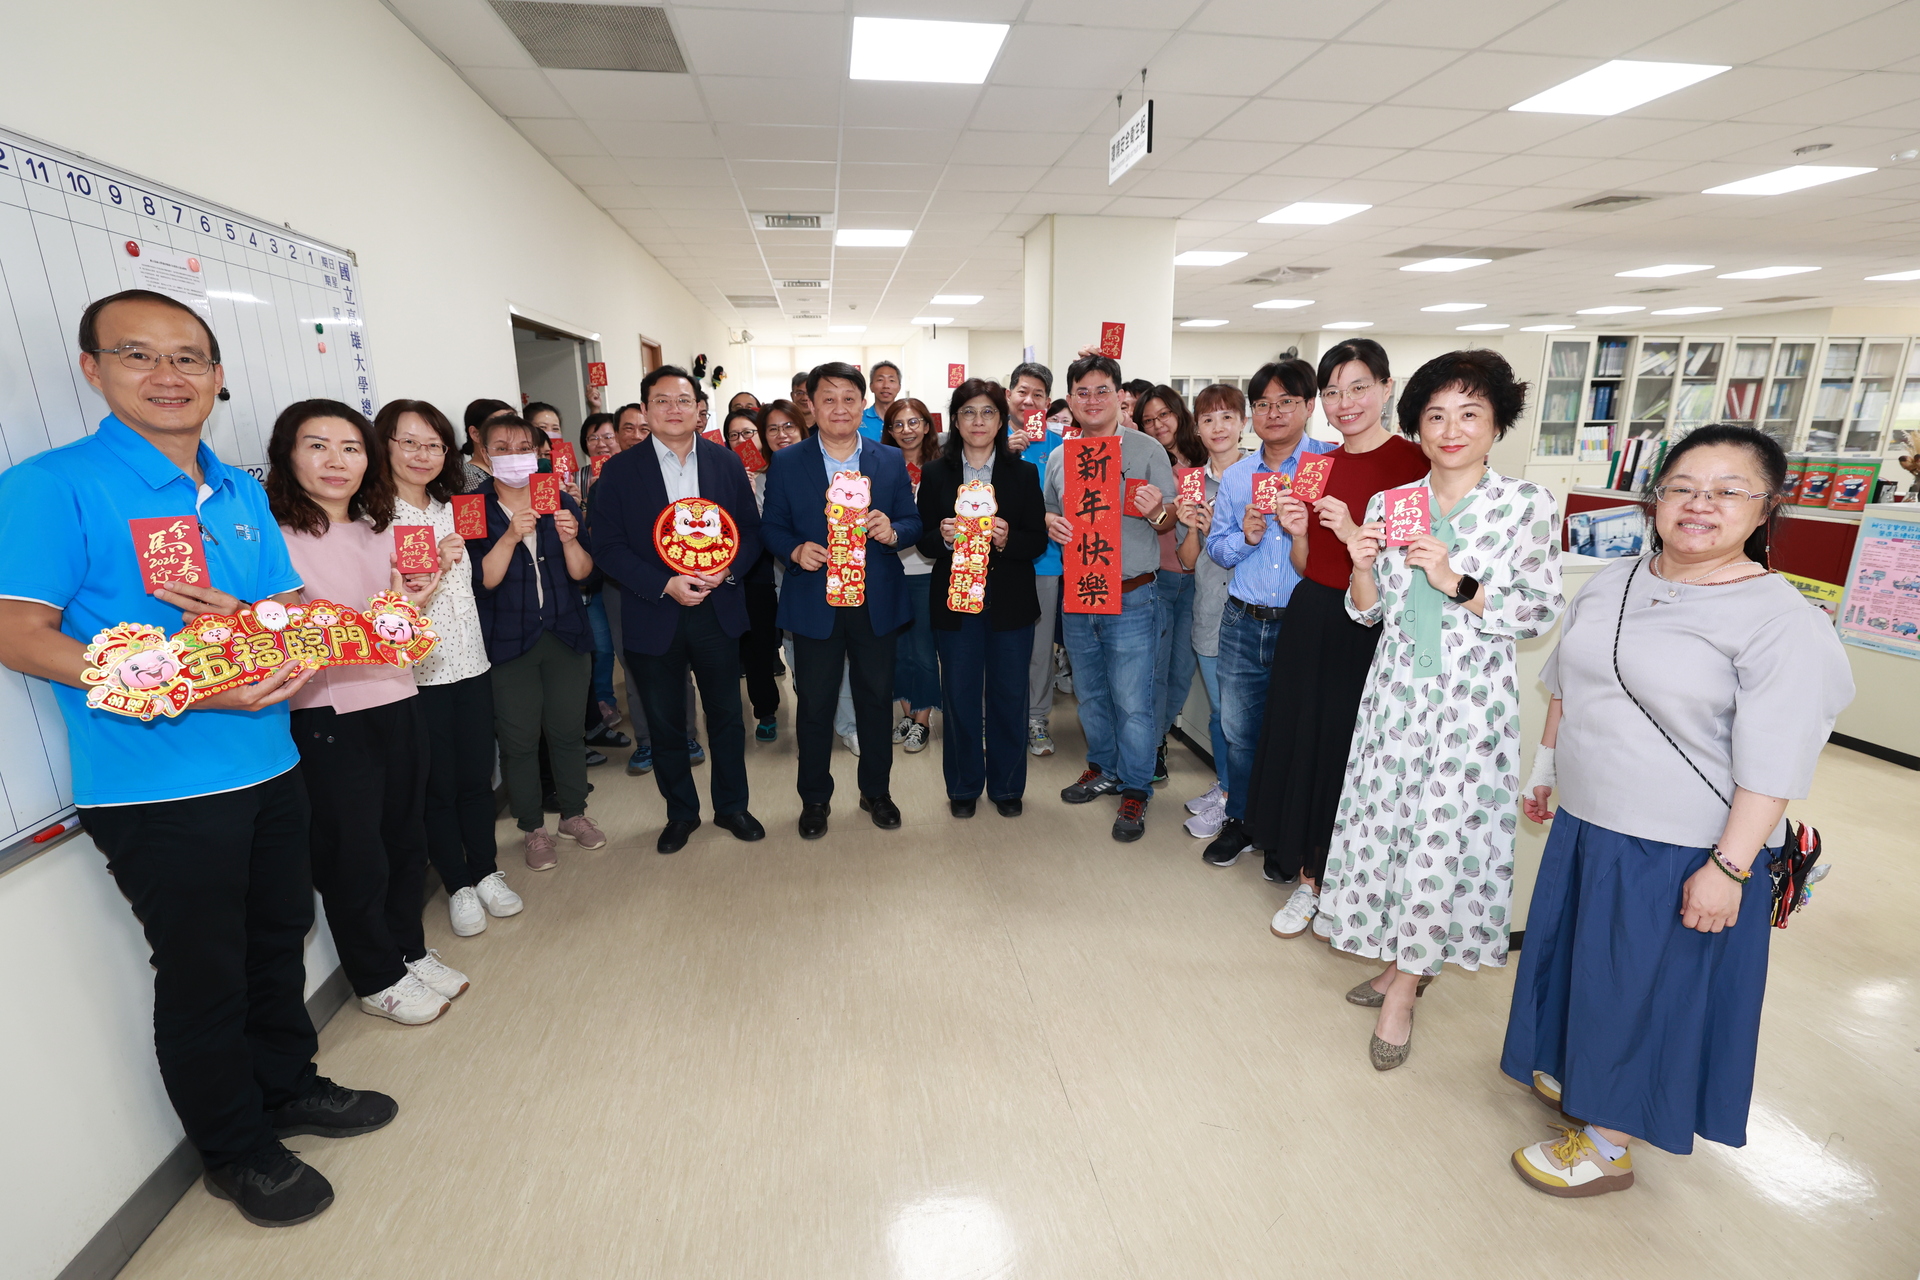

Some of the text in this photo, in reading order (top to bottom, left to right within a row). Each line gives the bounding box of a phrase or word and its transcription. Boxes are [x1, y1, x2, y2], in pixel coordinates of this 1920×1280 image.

[0, 148, 313, 264] 2 11 10 9 8 7 6 5 4 3 2 1
[338, 261, 374, 425] 國立高雄大學總
[1298, 459, 1328, 481] 金馬
[1389, 490, 1423, 520] 金馬
[143, 520, 193, 558] 金馬
[399, 528, 430, 551] 金馬
[1075, 442, 1114, 606] 新年快樂
[1392, 517, 1412, 528] 2026
[149, 554, 179, 569] 2026
[402, 549, 421, 558] 2026
[667, 544, 729, 568] 恭喜發財
[830, 525, 861, 604] 萬事如意
[952, 535, 989, 609] 恭喜發財
[182, 624, 371, 690] 五福臨門
